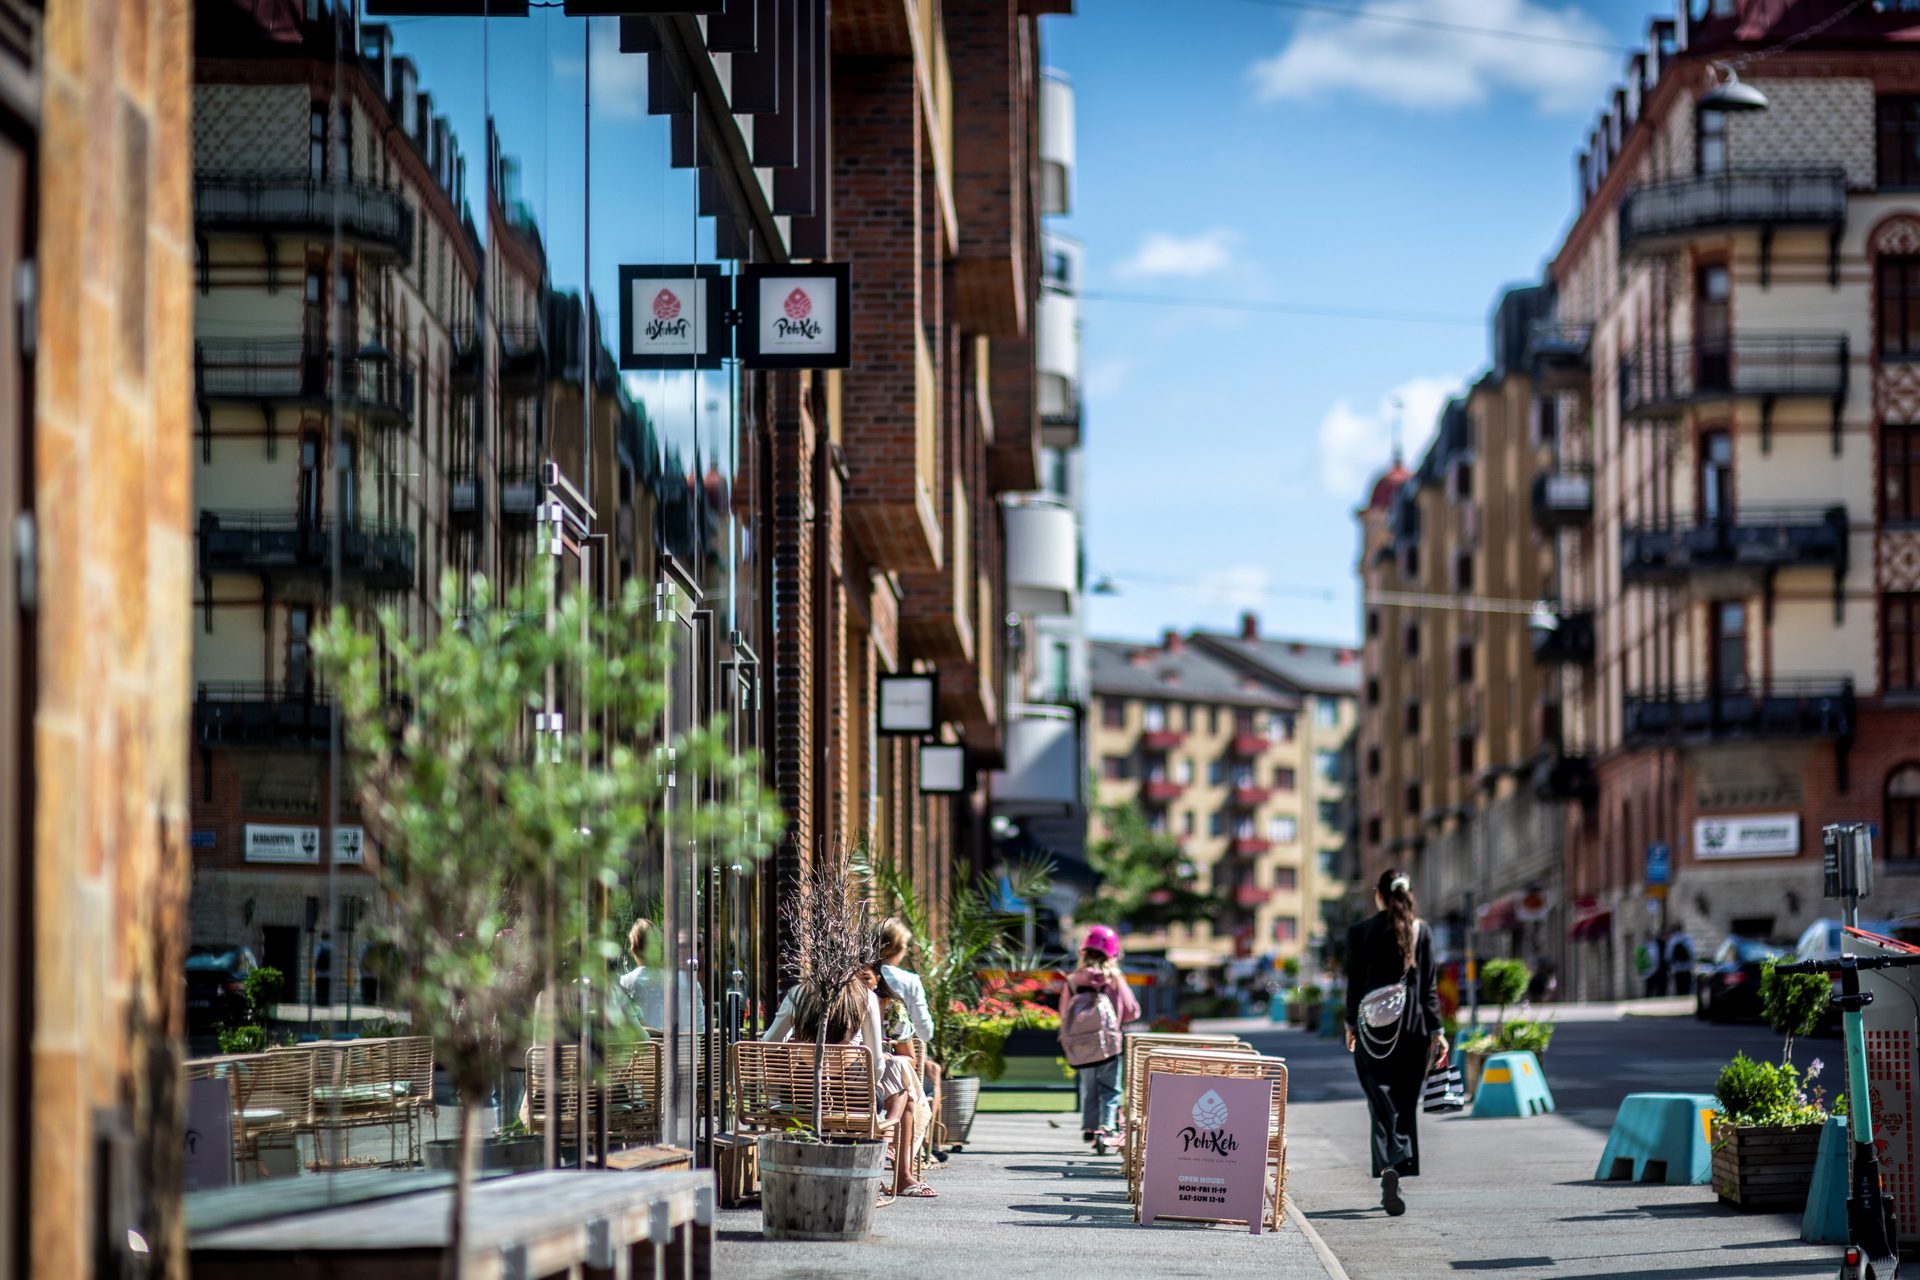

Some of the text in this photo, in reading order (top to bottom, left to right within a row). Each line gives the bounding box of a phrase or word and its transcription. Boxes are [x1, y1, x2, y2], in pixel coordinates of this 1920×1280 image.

[1177, 1127, 1239, 1156] PohKeh
[1200, 1176, 1225, 1184] HOURS
[1179, 1194, 1208, 1202] SAT-SUN
